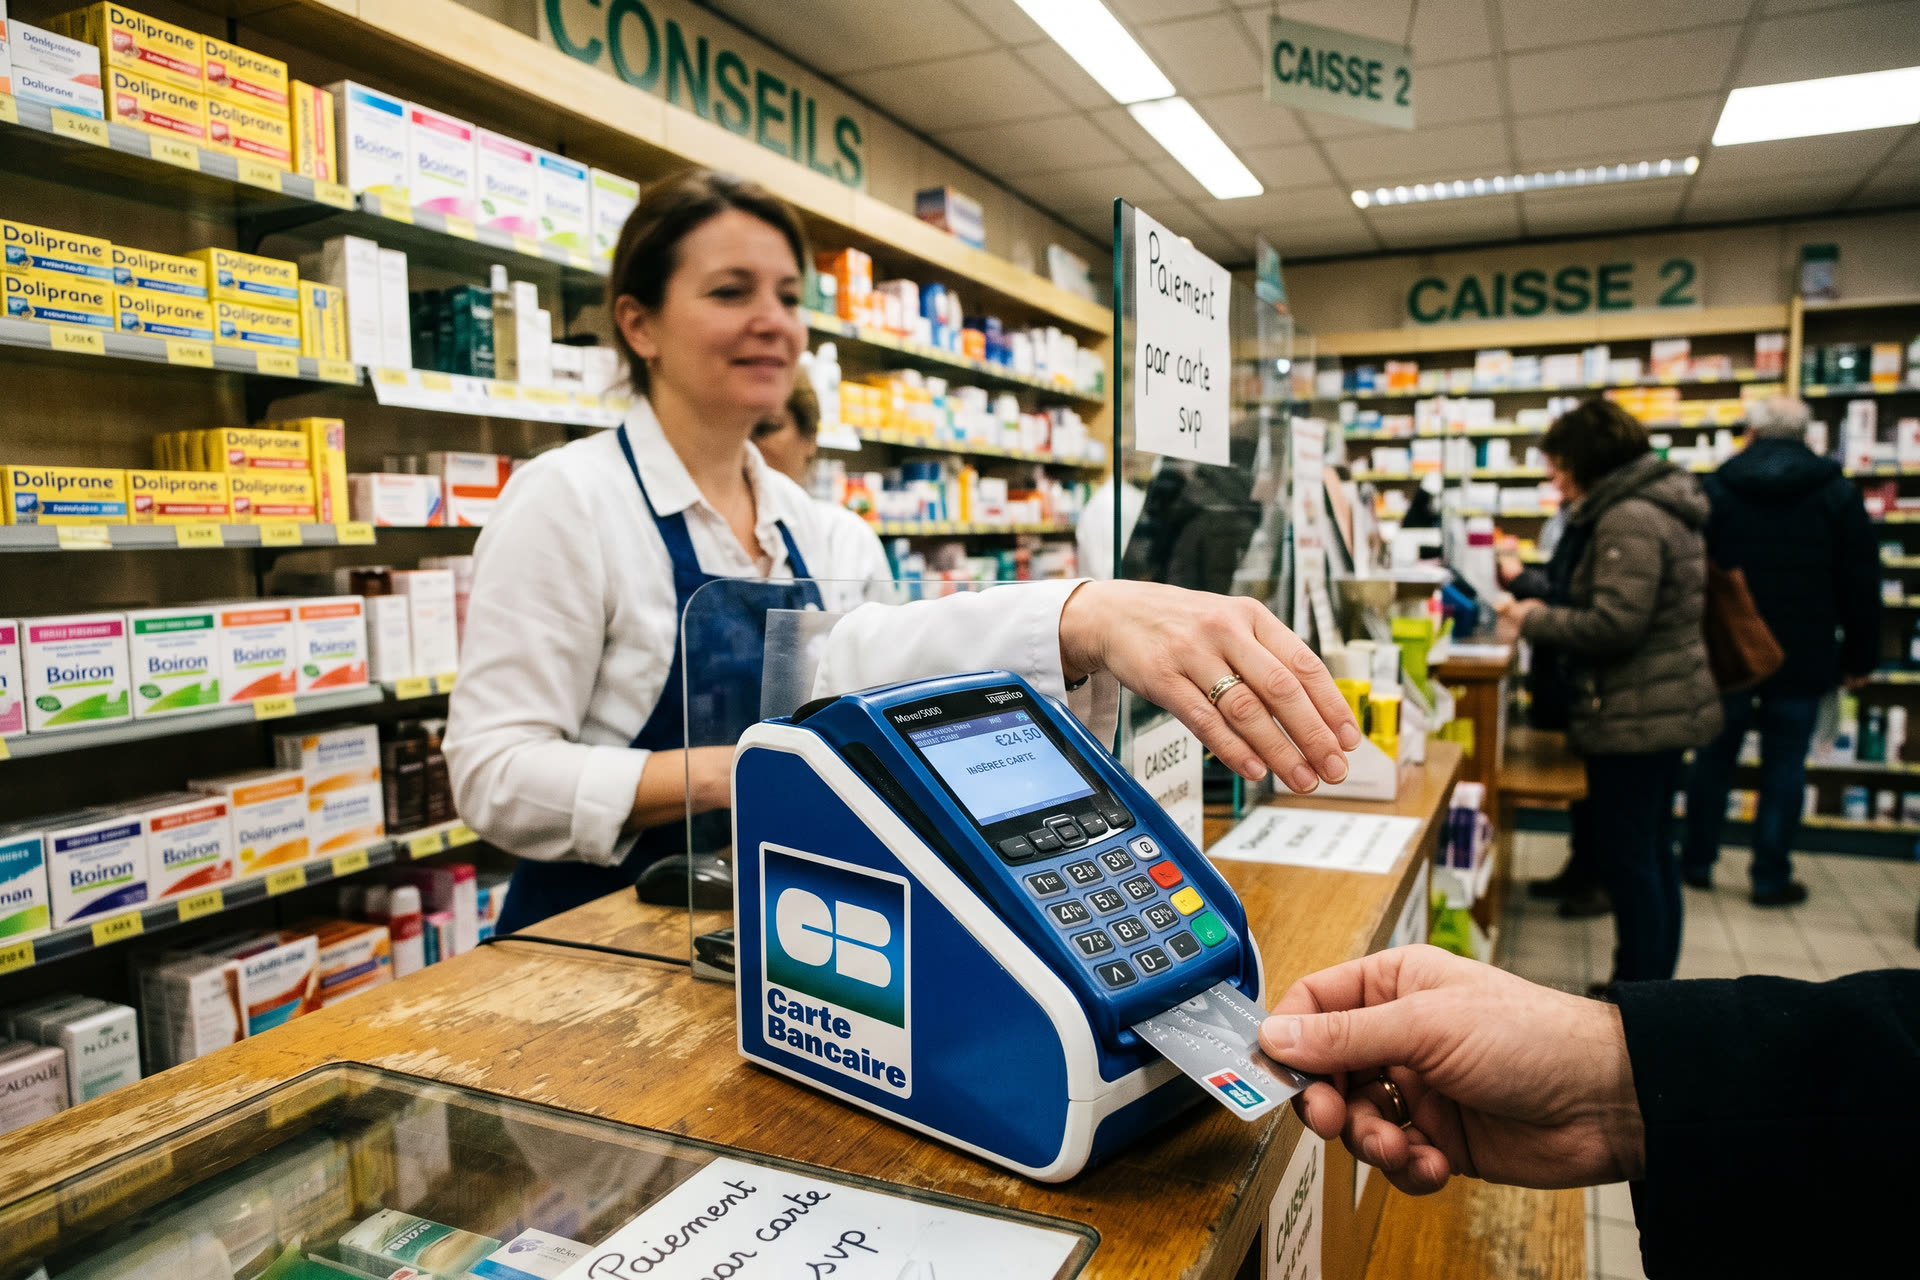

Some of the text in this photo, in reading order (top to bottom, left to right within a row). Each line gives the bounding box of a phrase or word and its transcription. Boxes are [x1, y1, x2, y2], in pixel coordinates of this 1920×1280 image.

[110, 8, 195, 50] Doliprane
[205, 41, 281, 79] Doliprane
[1273, 39, 1412, 107] CAISSE 2
[114, 73, 199, 111] Doliprane
[544, 0, 864, 190] CONSEILS
[208, 101, 283, 136] Doliprane
[3, 225, 102, 257] Doliprane
[112, 249, 198, 278] Doliprane
[217, 252, 291, 279] Doliprane
[1149, 231, 1215, 321] Paiement
[6, 277, 104, 306] Doliprane
[1407, 258, 1698, 324] CAISSE 2
[119, 294, 205, 321] Doliprane
[219, 303, 293, 328] Doliprane
[1145, 343, 1211, 396] par carte
[227, 432, 301, 449] Doliprane
[1179, 406, 1202, 449] svp
[13, 471, 114, 493] Doliprane
[133, 475, 219, 494] Doliprane
[232, 479, 306, 495] Doliprane
[233, 645, 288, 664] Boiron
[309, 637, 357, 656] Boiron
[47, 664, 115, 684] Boiron
[149, 654, 209, 674] Boiron
[995, 727, 1042, 747] €24,50
[1006, 752, 1037, 766] CARTE
[1145, 740, 1181, 780] CAISSE
[163, 841, 220, 865] Boiron
[1106, 855, 1120, 868] 3
[70, 861, 134, 888] Boiron
[1037, 877, 1050, 890] 1
[1072, 866, 1087, 880] 2
[1099, 894, 1110, 909] 5
[1128, 883, 1141, 897] 6
[1061, 906, 1073, 920] 4
[1152, 910, 1165, 925] 9
[776, 887, 892, 988] CB
[1082, 936, 1095, 952] 7
[1118, 923, 1131, 938] 8
[1141, 953, 1156, 970] 0
[767, 988, 852, 1040] Carte
[768, 1014, 907, 1088] Bancaire
[1276, 1161, 1310, 1265] CAISSE
[588, 1180, 757, 1280] Paiement
[699, 1190, 832, 1280] ar carte
